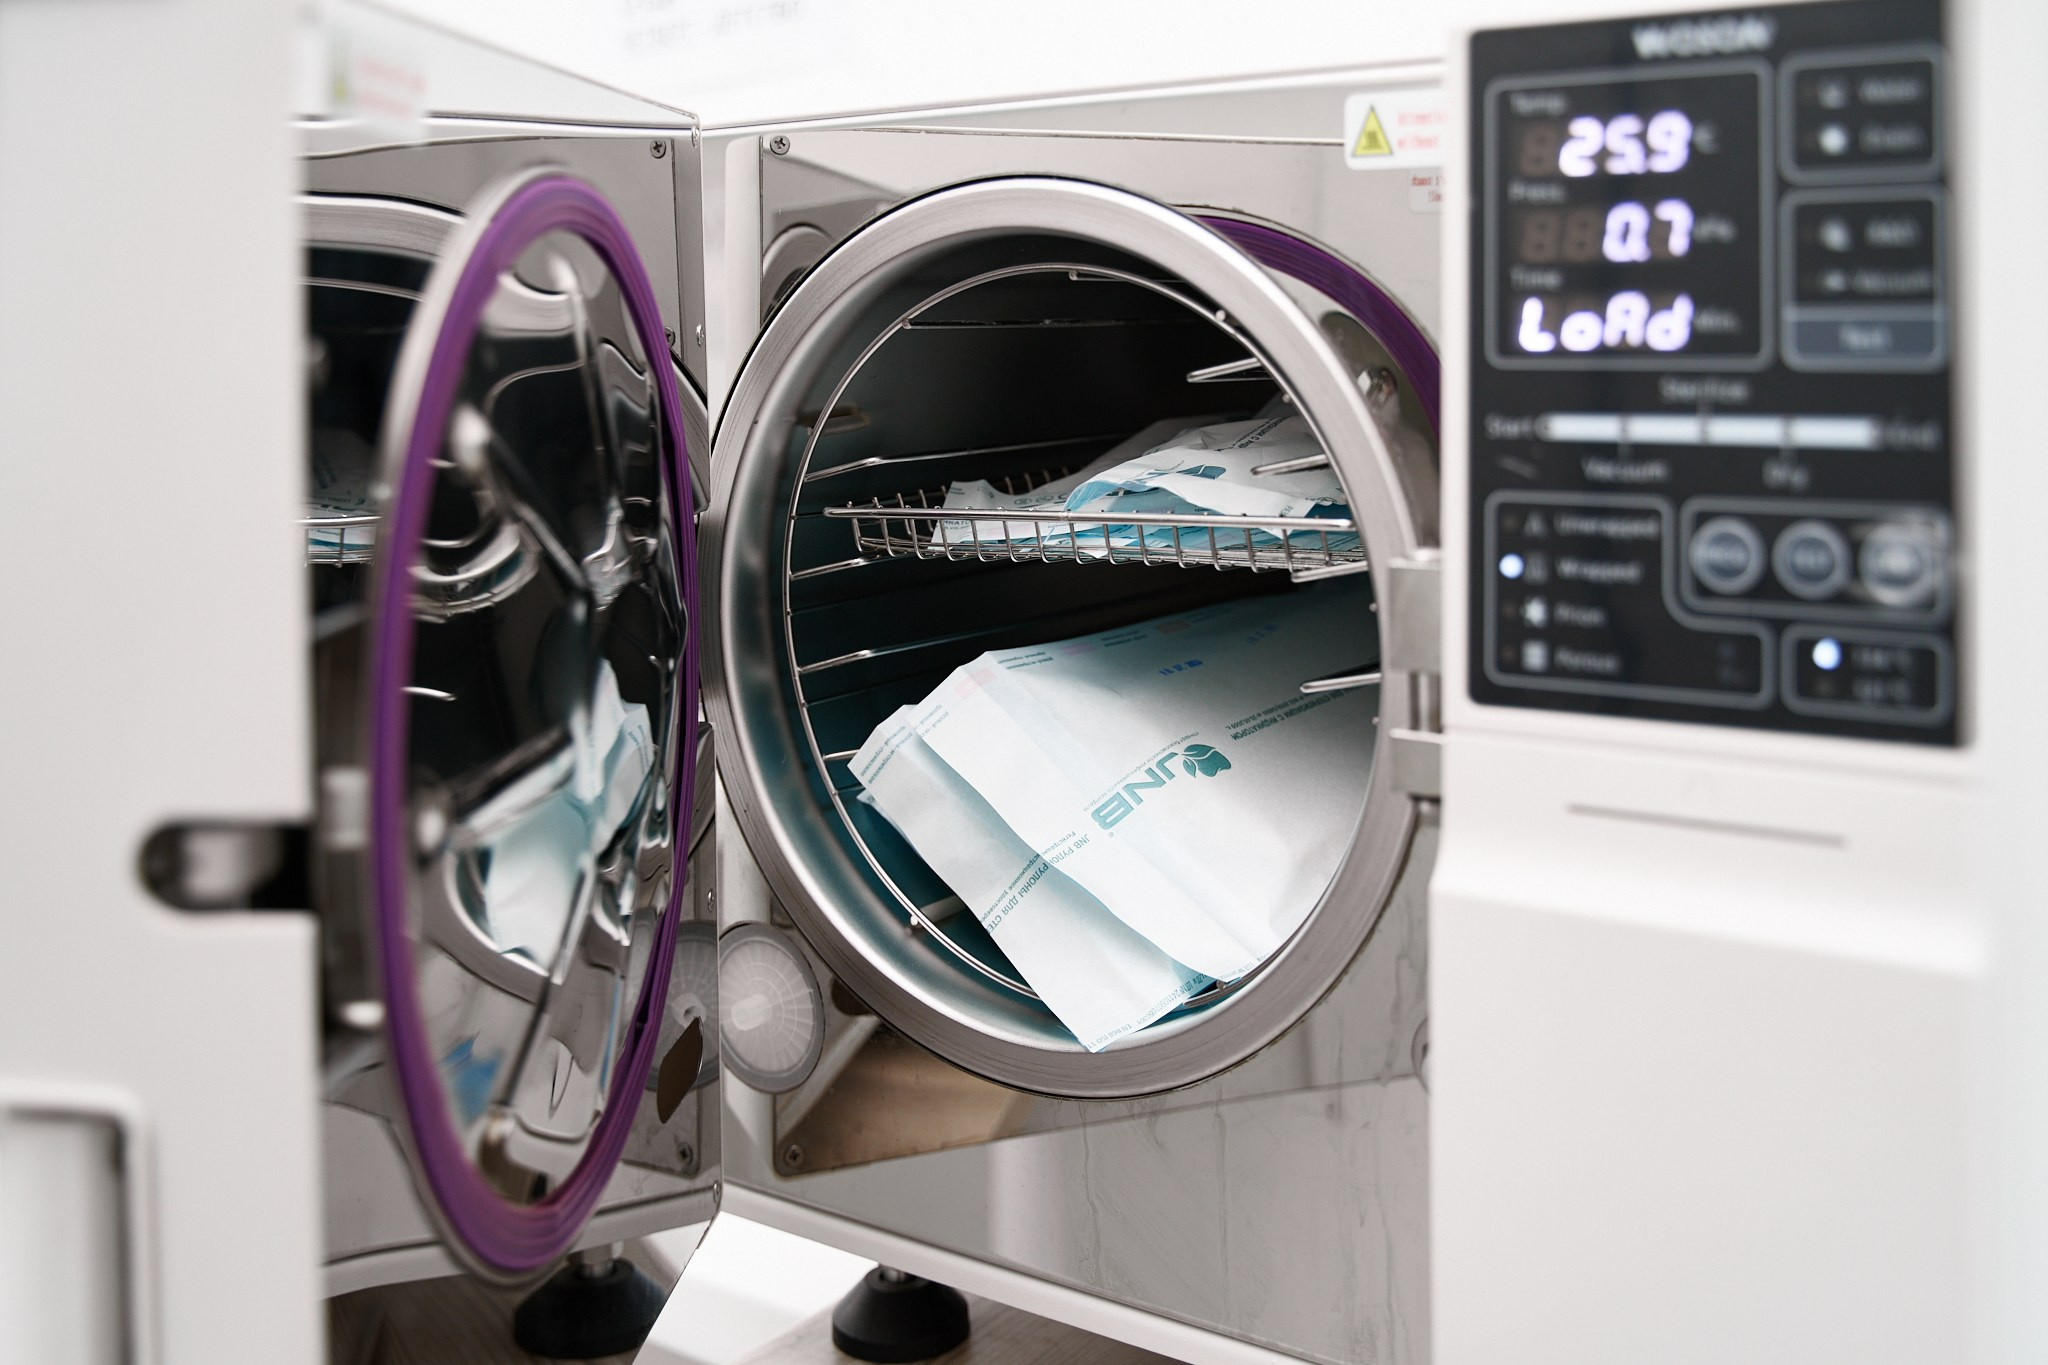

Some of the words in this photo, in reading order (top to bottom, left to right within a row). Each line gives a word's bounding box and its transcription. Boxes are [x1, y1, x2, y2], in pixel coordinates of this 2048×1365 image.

[1091, 749, 1180, 831] JNB
[1072, 833, 1091, 850] JNB
[1016, 862, 1049, 898] РУЛОНЫ
[1000, 894, 1020, 915] ДЛЯ
